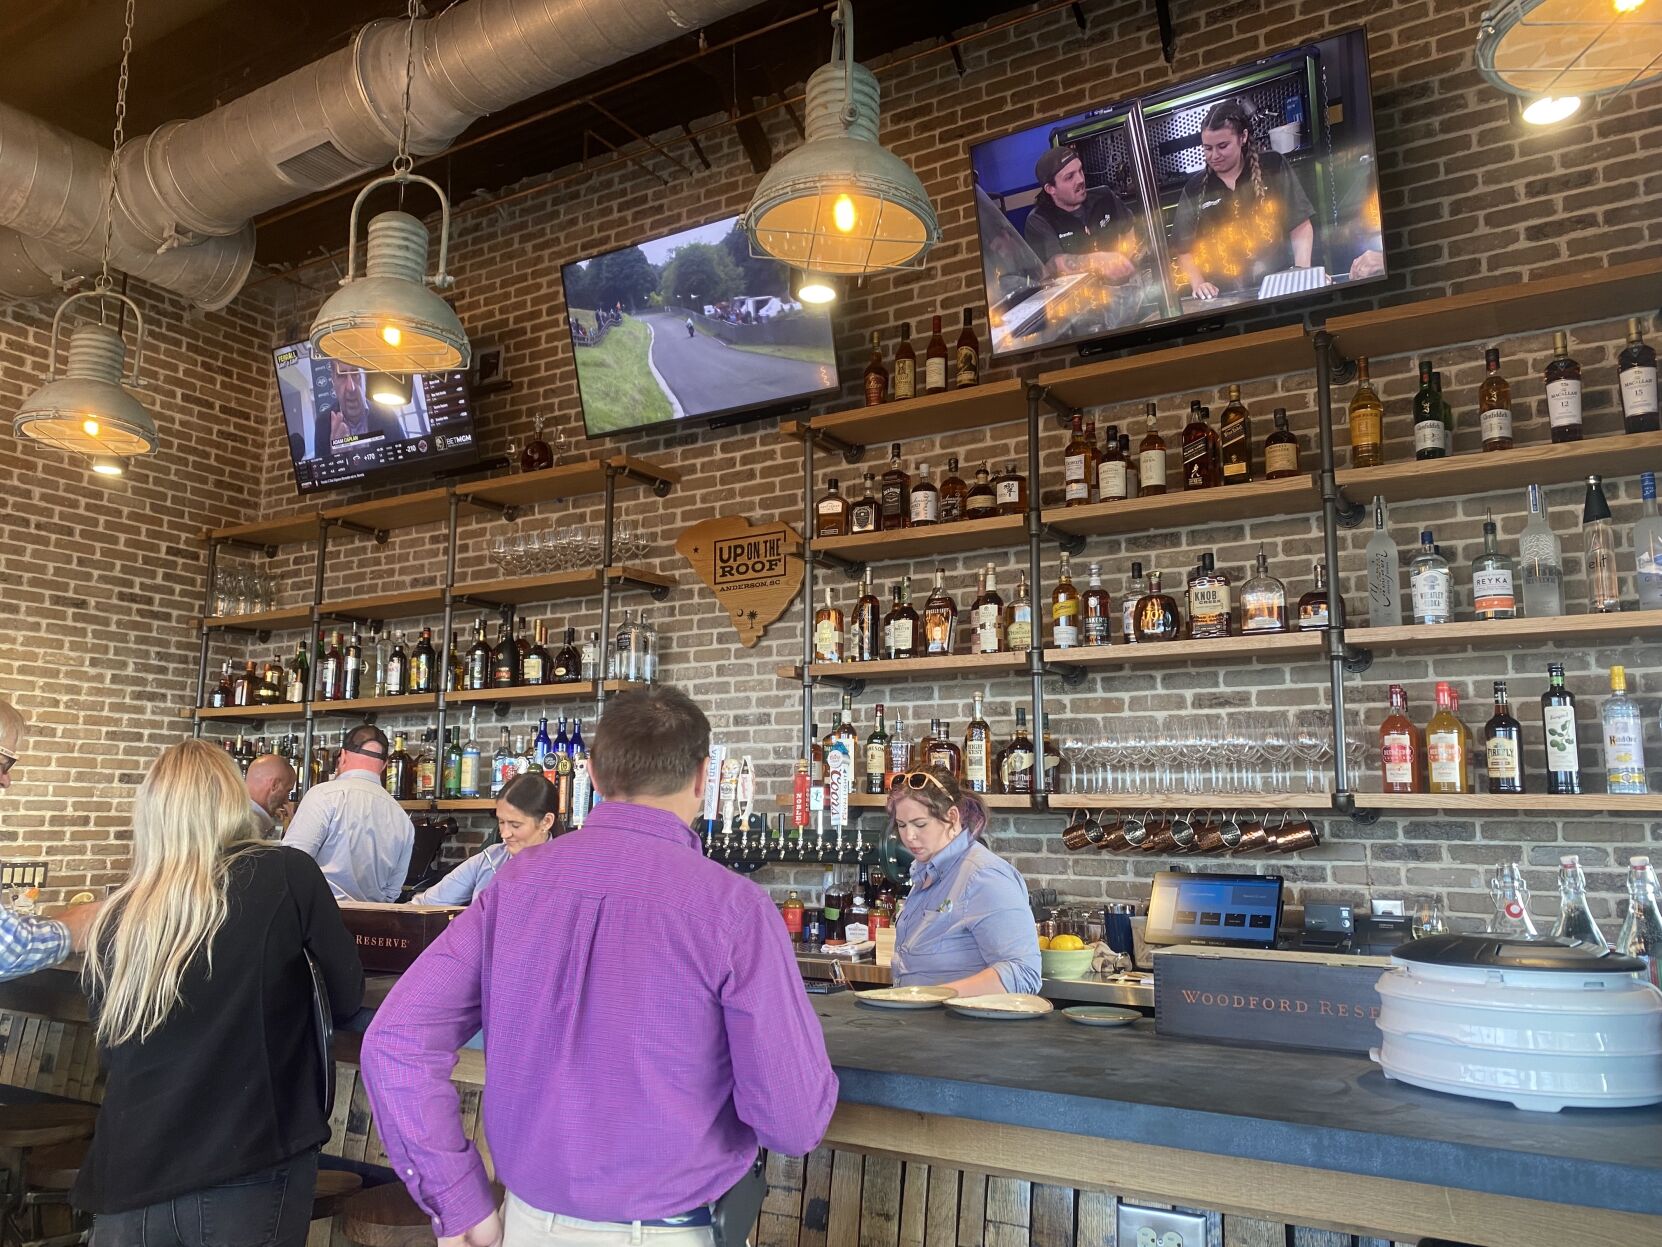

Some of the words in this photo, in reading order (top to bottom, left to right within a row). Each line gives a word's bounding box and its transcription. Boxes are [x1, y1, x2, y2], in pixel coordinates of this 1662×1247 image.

[719, 544, 744, 563] UP
[747, 541, 760, 560] ON
[763, 538, 781, 558] THE
[719, 558, 781, 577] ROOF
[720, 582, 768, 592] ANDERSON,
[1476, 577, 1507, 586] REYKA
[1194, 590, 1217, 601] KNOB
[355, 934, 407, 948] RESERVE
[1182, 989, 1308, 1013] WOODFORD
[1319, 1000, 1380, 1019] RESE
